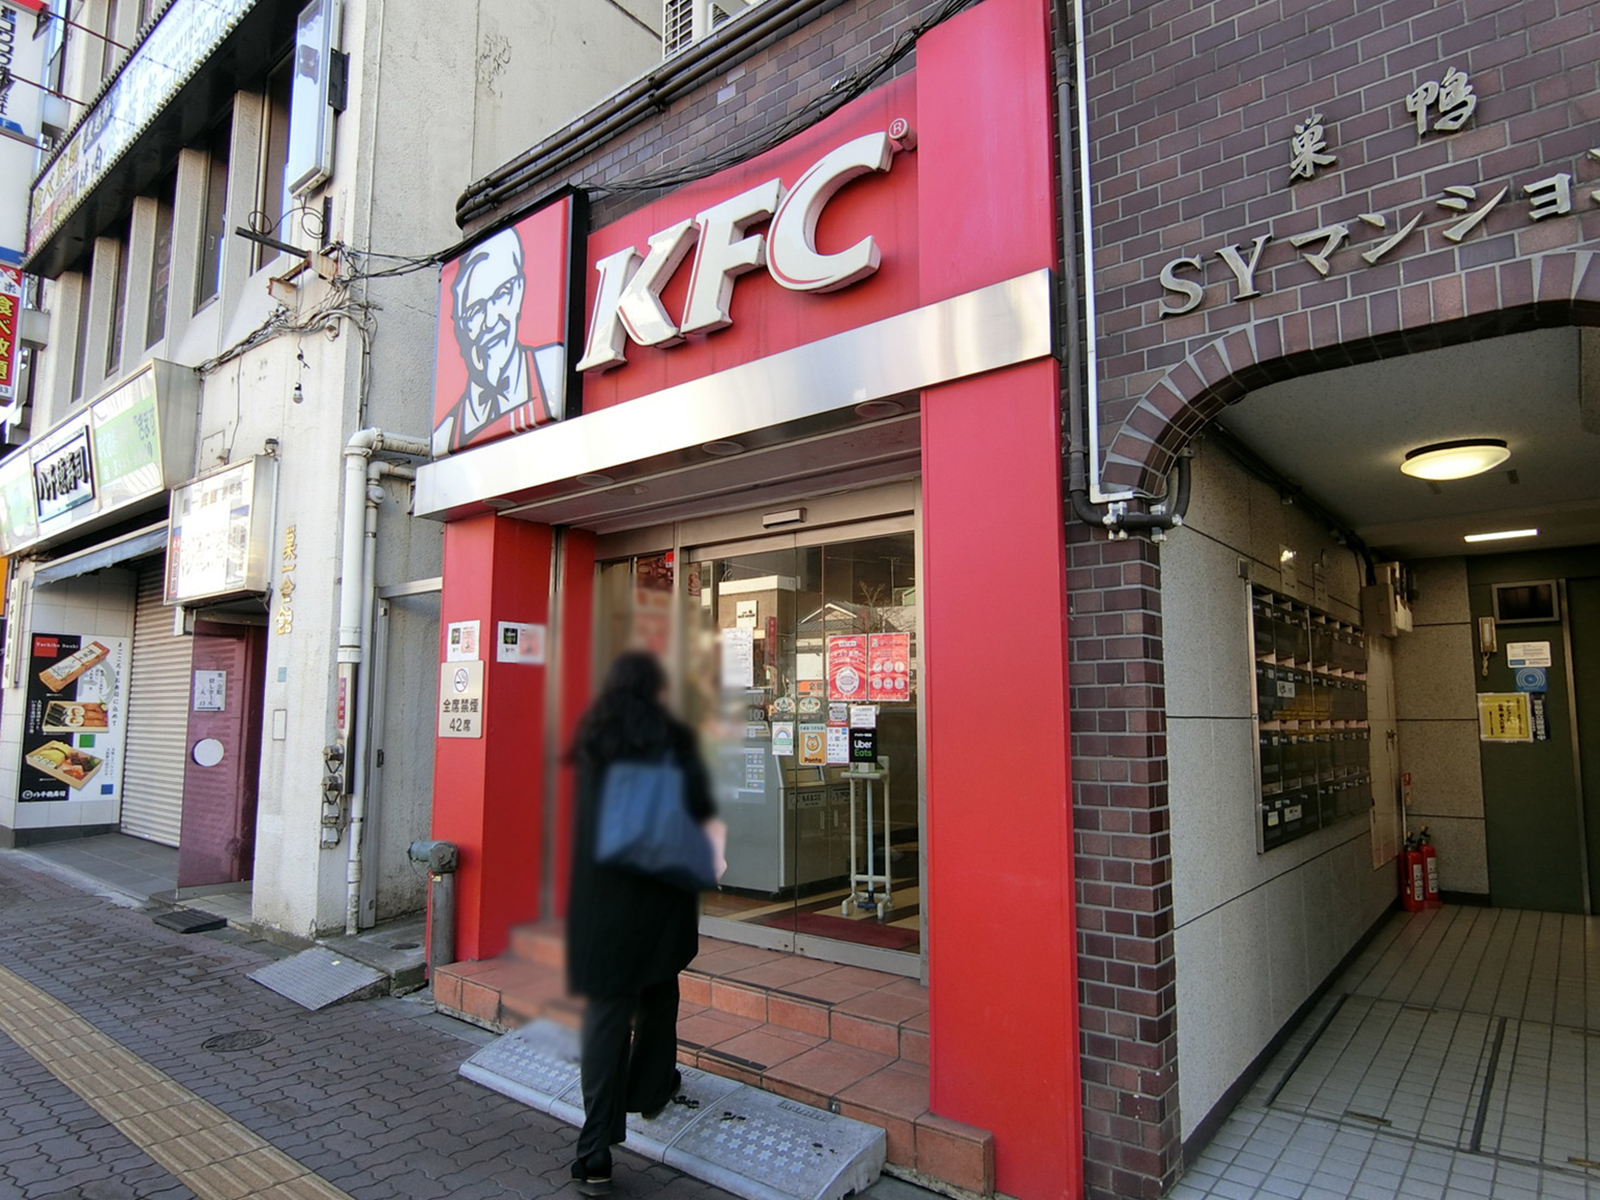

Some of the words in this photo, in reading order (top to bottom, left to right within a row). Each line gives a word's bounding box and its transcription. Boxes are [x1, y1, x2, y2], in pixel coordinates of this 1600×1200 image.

[1288, 66, 1478, 184] 巣鴨
[1159, 148, 1600, 318] SYマンショ
[576, 131, 894, 373] KFC
[443, 698, 479, 713] 全席禁煙
[449, 718, 472, 732] 42席
[854, 740, 872, 748] Uber
[854, 749, 872, 757] Eats
